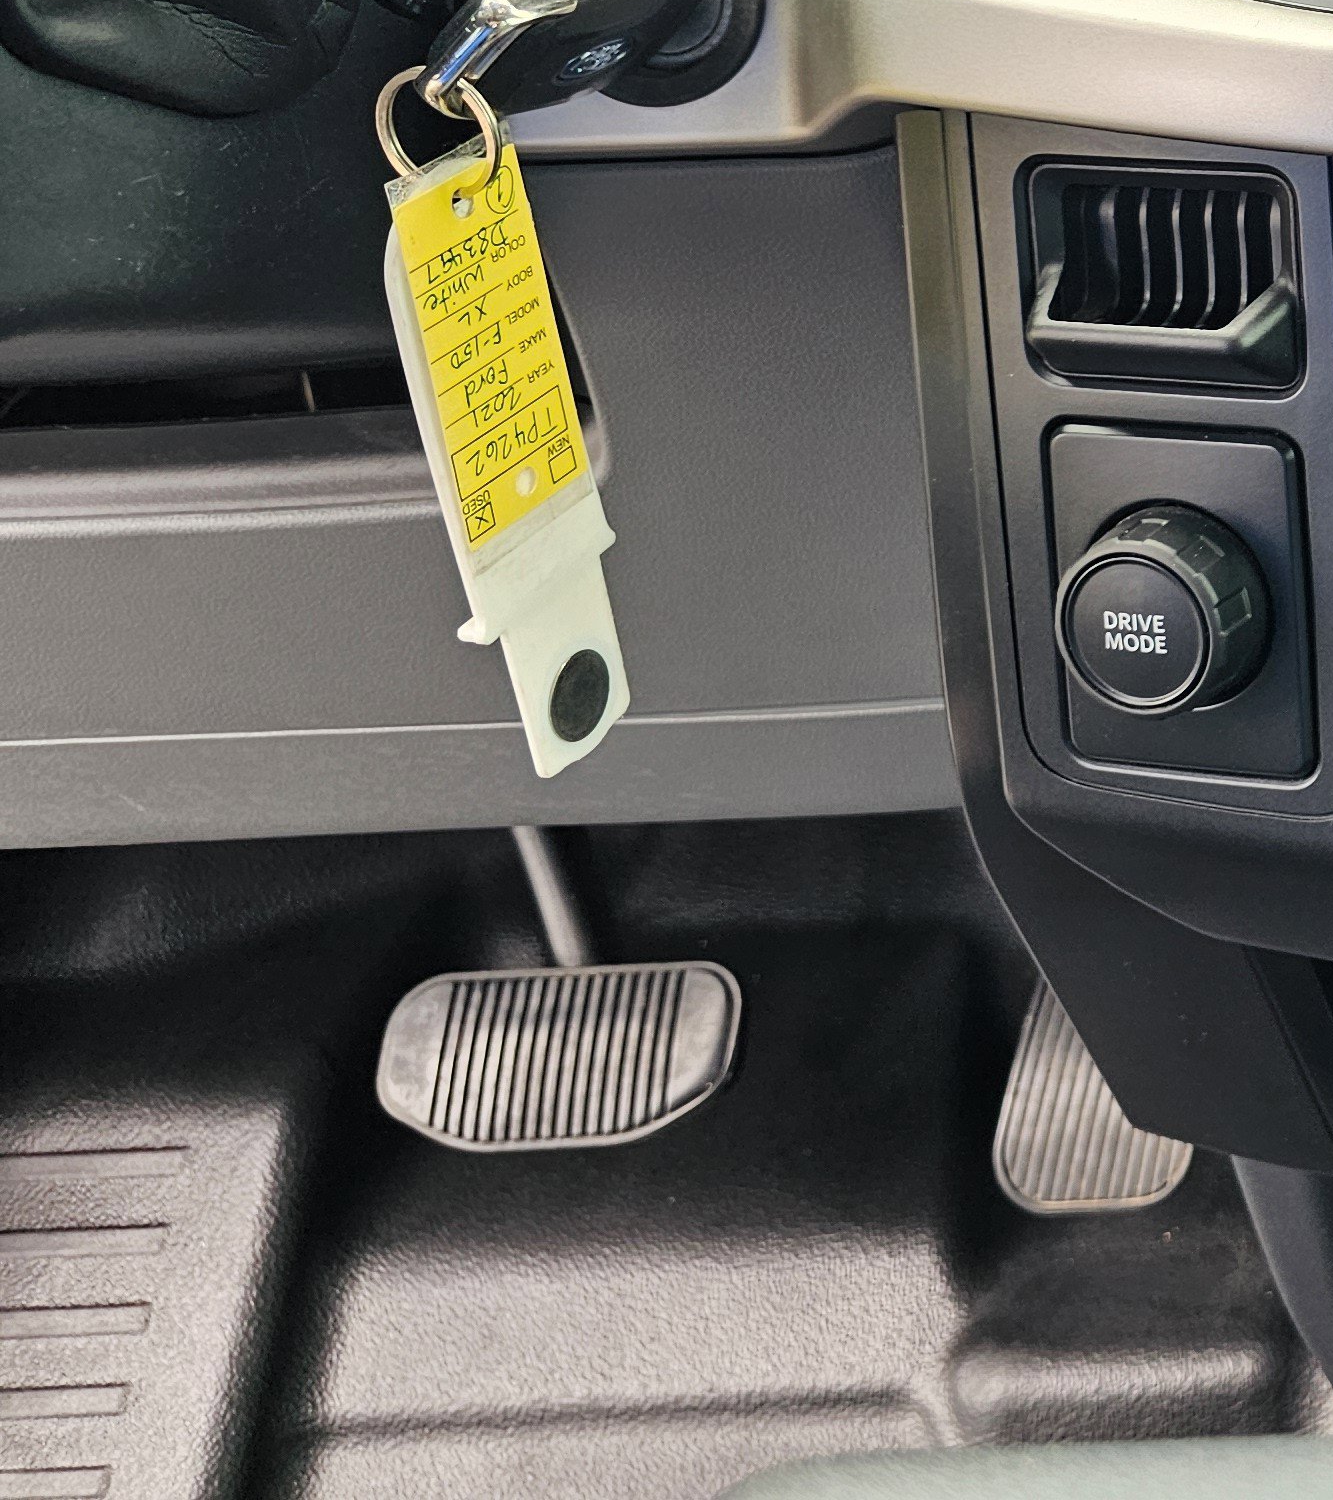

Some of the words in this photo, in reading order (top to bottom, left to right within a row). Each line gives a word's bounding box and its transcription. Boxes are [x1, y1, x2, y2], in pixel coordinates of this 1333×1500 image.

[491, 234, 526, 264] COLOR
[423, 263, 485, 314] White
[506, 265, 534, 291] BODY
[504, 296, 541, 325] MODEL
[451, 321, 502, 370] F-150
[518, 327, 548, 354] MAKE
[464, 358, 509, 408] Ford
[527, 359, 555, 384] YEAR
[472, 385, 522, 428] 2021
[465, 407, 558, 477] TP4262
[547, 435, 571, 458] NEW
[462, 489, 491, 515] USED
[1103, 610, 1166, 634] DRIVE
[1104, 632, 1168, 654] MODE
